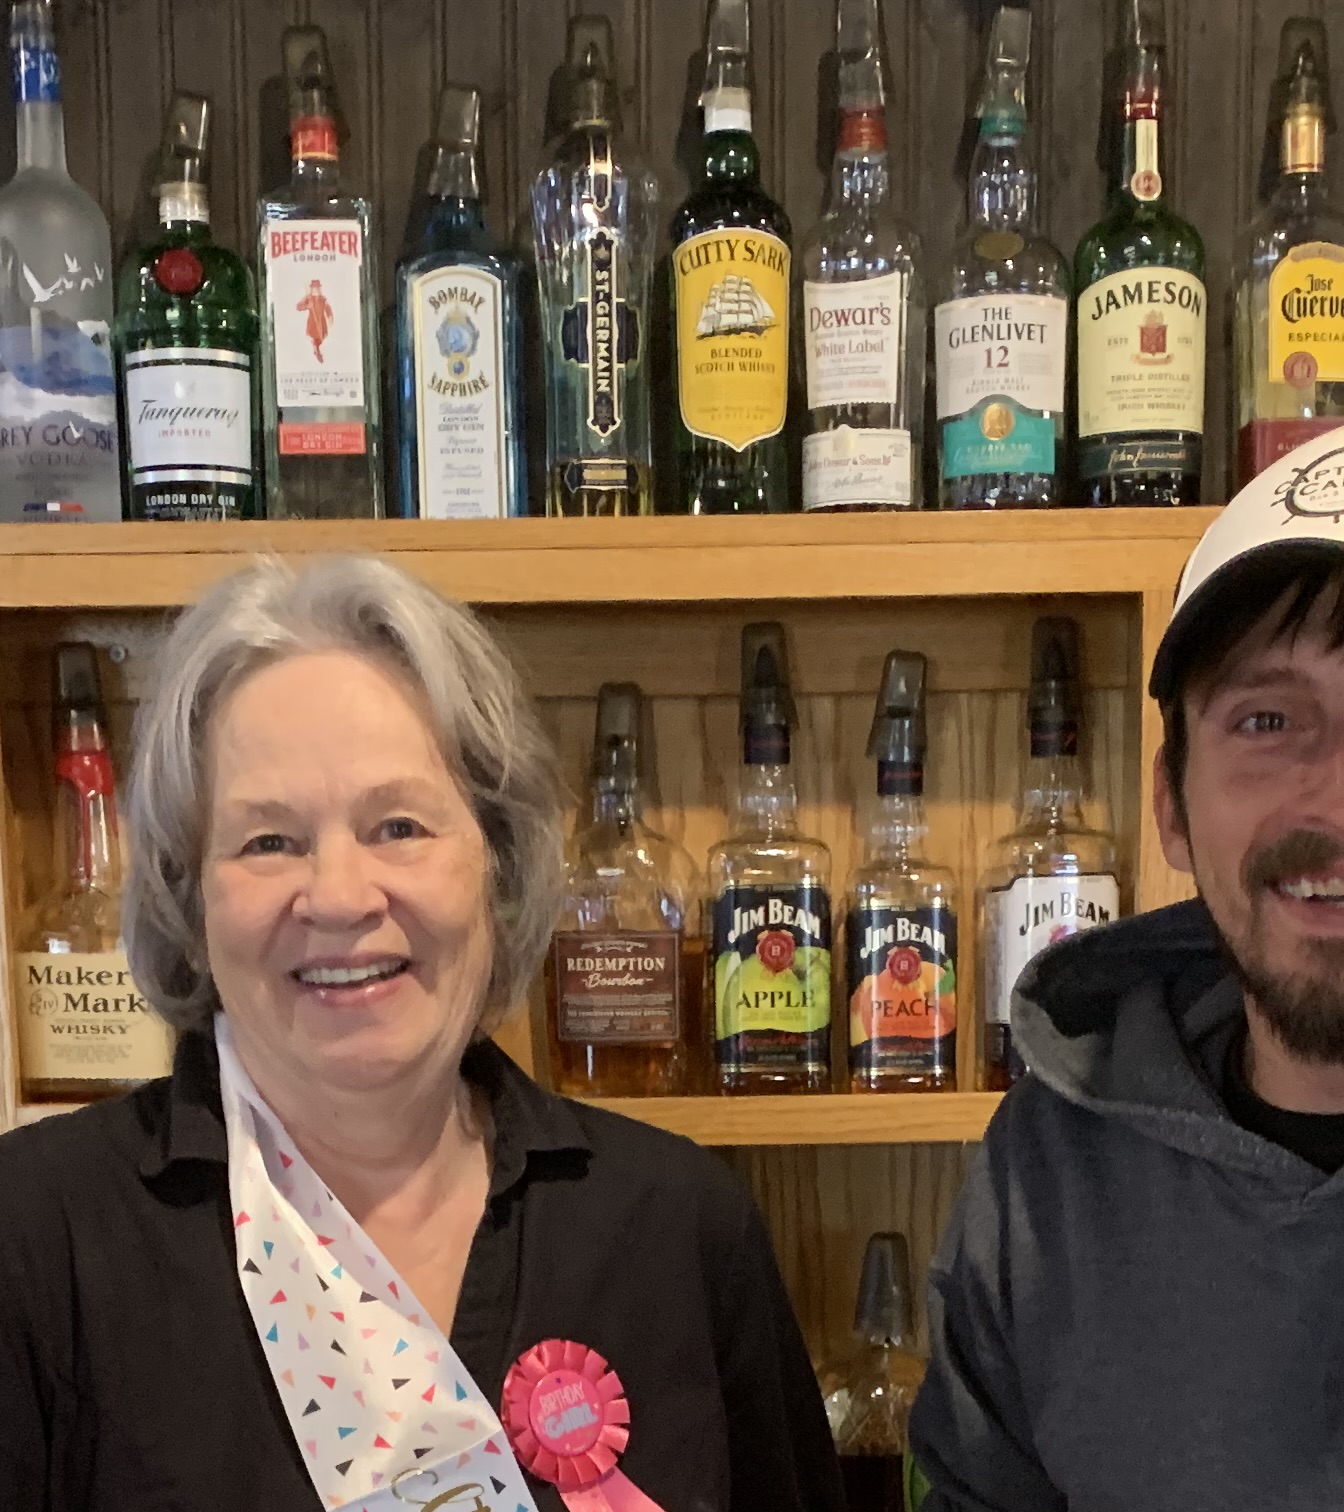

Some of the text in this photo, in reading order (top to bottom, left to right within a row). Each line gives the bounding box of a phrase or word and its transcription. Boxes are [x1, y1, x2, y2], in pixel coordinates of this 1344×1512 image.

[270, 230, 359, 258] BEEFEATER
[293, 253, 337, 262] LONDON
[679, 239, 787, 277] CUTTY SARK
[1306, 273, 1334, 295] Jose
[428, 286, 487, 315] BOMBAY
[1090, 280, 1203, 322] JAMESON
[809, 302, 892, 332] Dewar's
[981, 307, 1013, 323] THE
[595, 269, 611, 393] ST-GERMAIN
[948, 323, 1048, 350] GLENLIVET
[710, 347, 762, 359] BLENDED
[984, 345, 1010, 369] 12
[694, 361, 735, 375] SCOTCH
[427, 371, 490, 398] SAPPHIRE
[138, 399, 239, 428] Tanqueray
[301, 432, 343, 442] LONDON
[301, 441, 343, 450] DRY GIN
[145, 493, 236, 507] LONDON DRY GIN
[727, 898, 821, 944] JIM BEAM
[1018, 892, 1110, 937] JIM BEAM
[860, 917, 946, 960] JIM BEAM
[27, 965, 131, 986] Maker
[566, 957, 666, 972] REDEMPTION
[584, 973, 646, 989] Bourbon
[62, 993, 149, 1014] Mark
[735, 990, 817, 1009] APPLE
[871, 998, 937, 1018] PEACH
[49, 1024, 132, 1035] WHISKY
[537, 1380, 587, 1417] BIRTHDAY
[543, 1403, 599, 1439] GIRL
